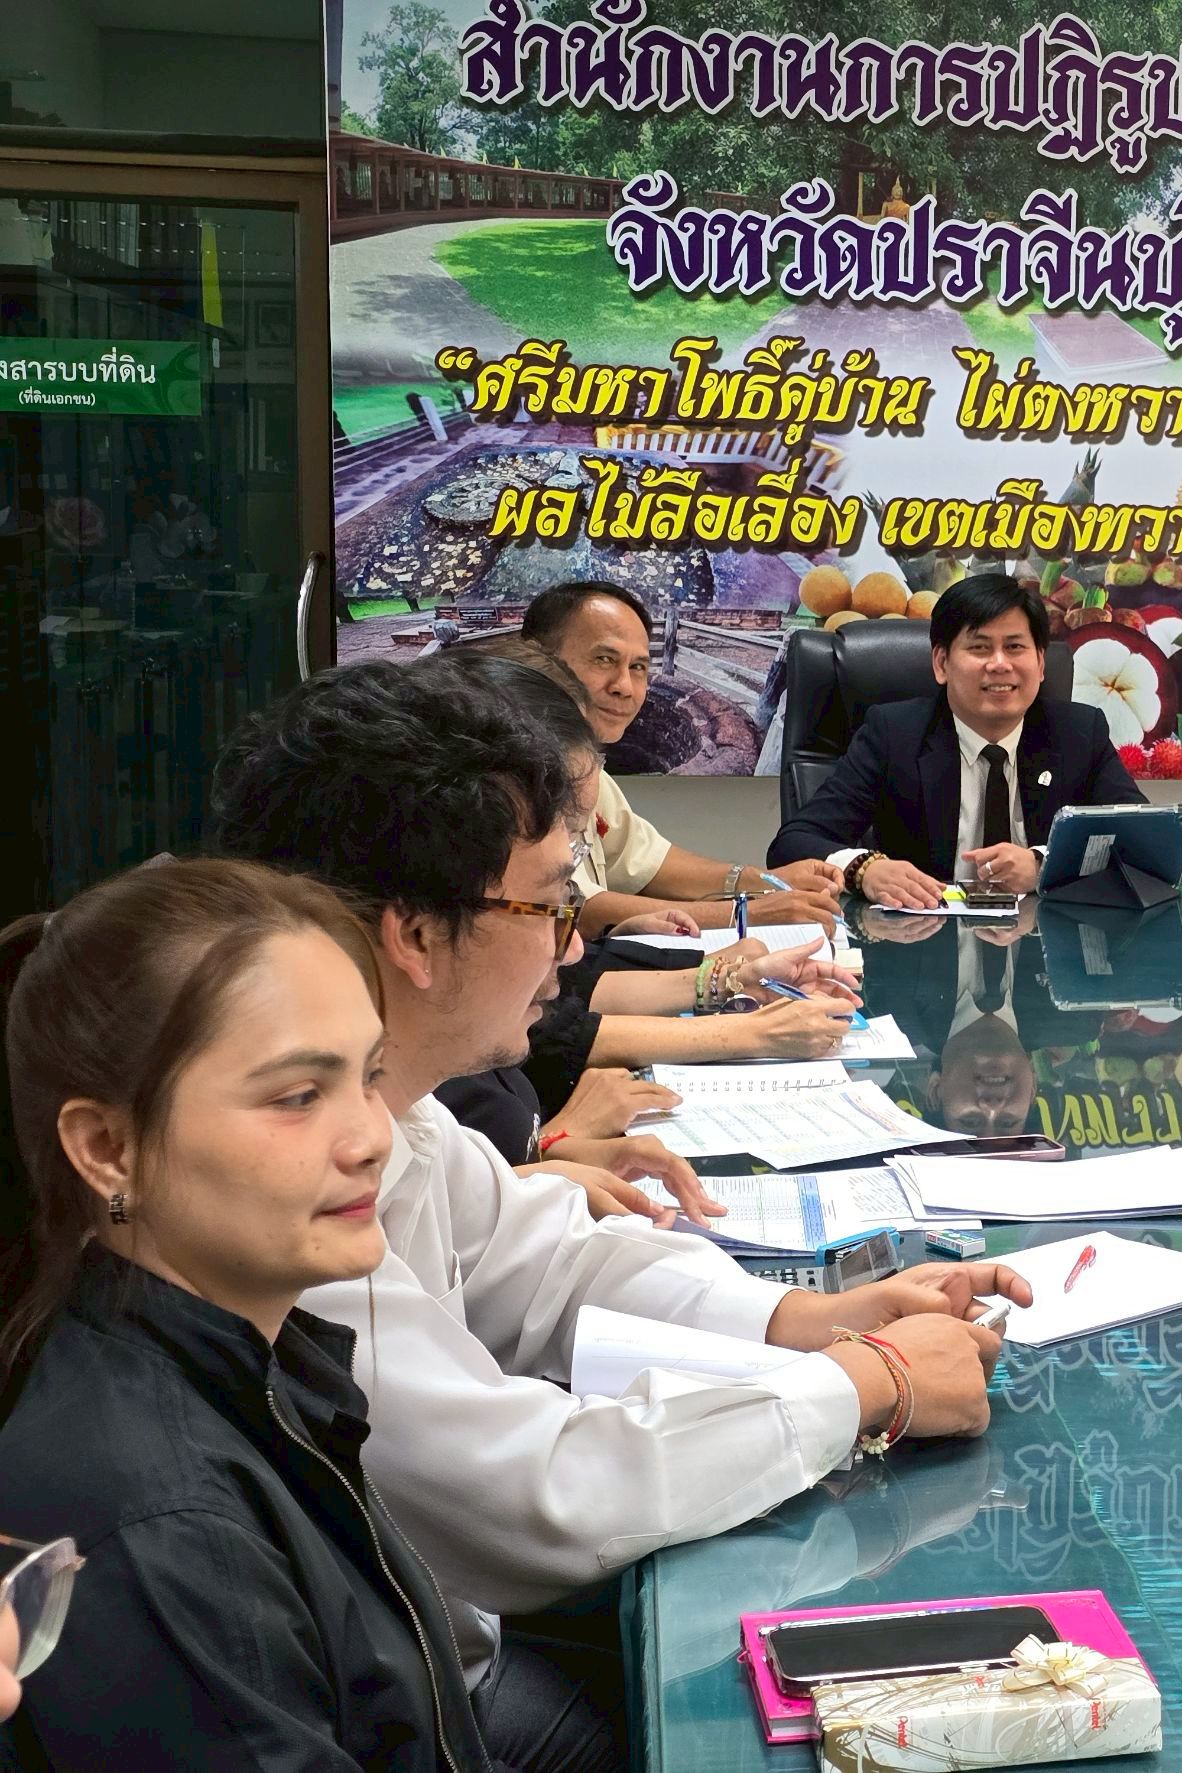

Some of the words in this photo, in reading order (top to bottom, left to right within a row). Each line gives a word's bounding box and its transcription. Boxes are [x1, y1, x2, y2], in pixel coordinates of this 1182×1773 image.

[18, 386, 96, 406] (ที่ดินเอกชน)
[488, 458, 860, 546] ผลไม้ลือเลื่อง
